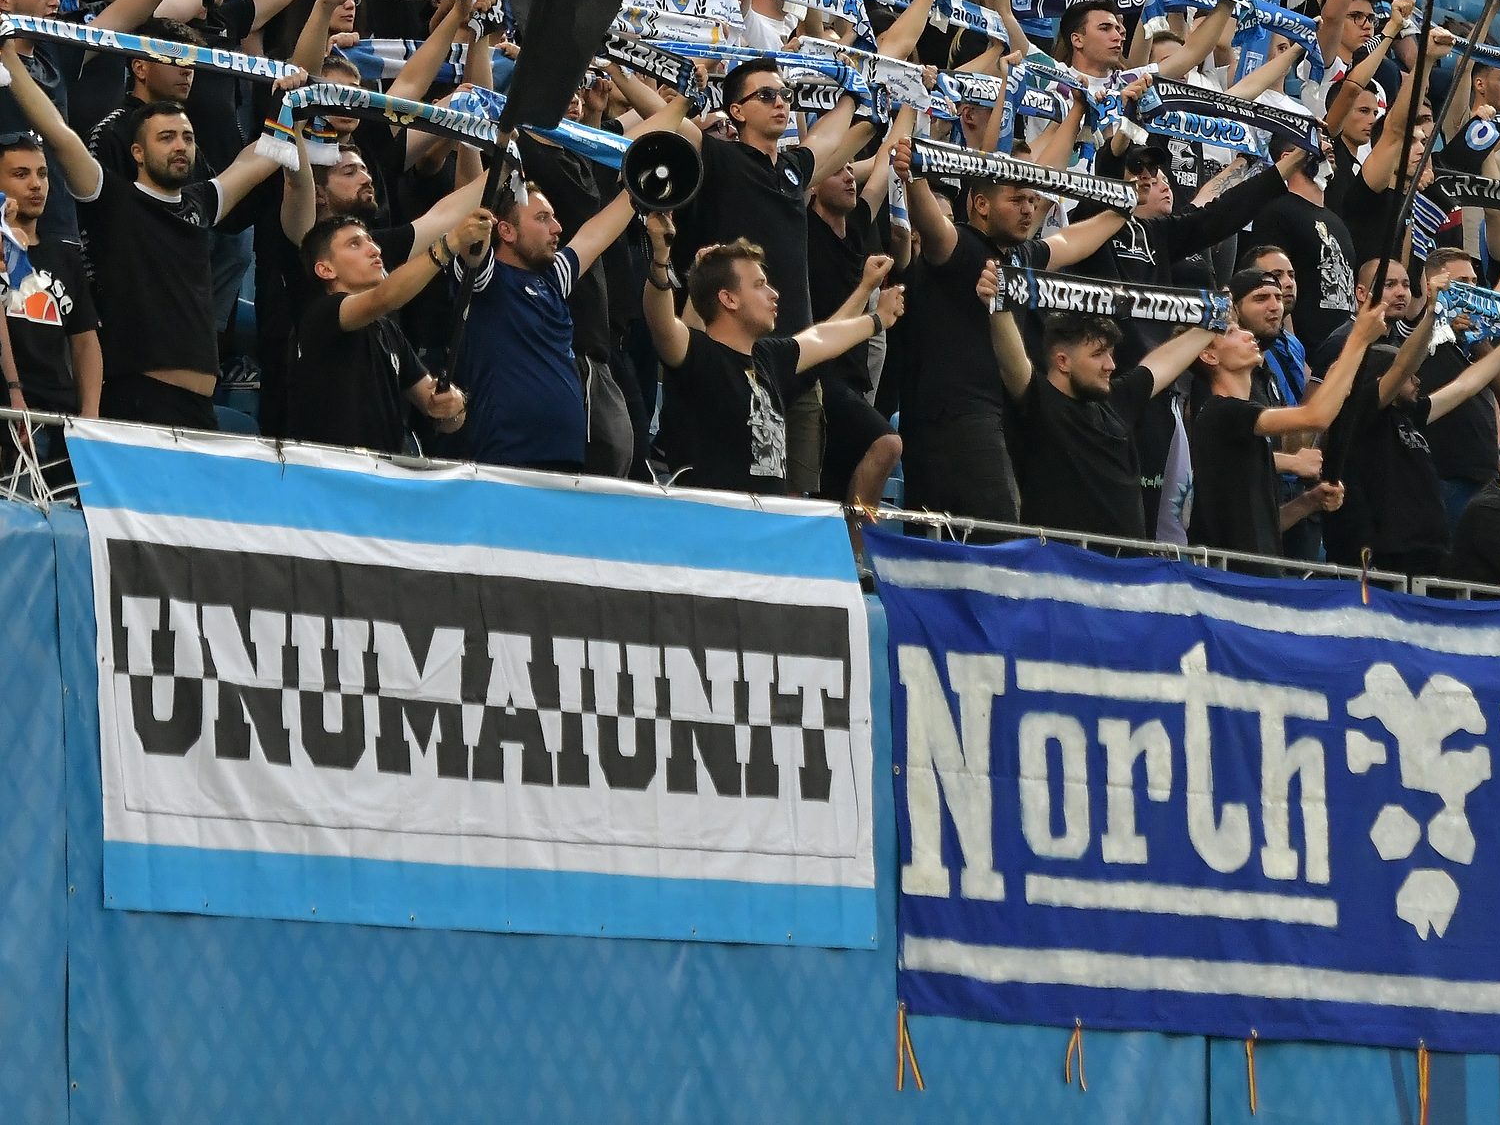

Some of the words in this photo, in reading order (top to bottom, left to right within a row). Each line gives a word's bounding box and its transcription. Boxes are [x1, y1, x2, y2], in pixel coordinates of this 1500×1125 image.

[1183, 115, 1247, 143] NORD
[1035, 277, 1113, 315] NORTH
[1129, 290, 1204, 324] LIONS
[897, 641, 1331, 902] North
